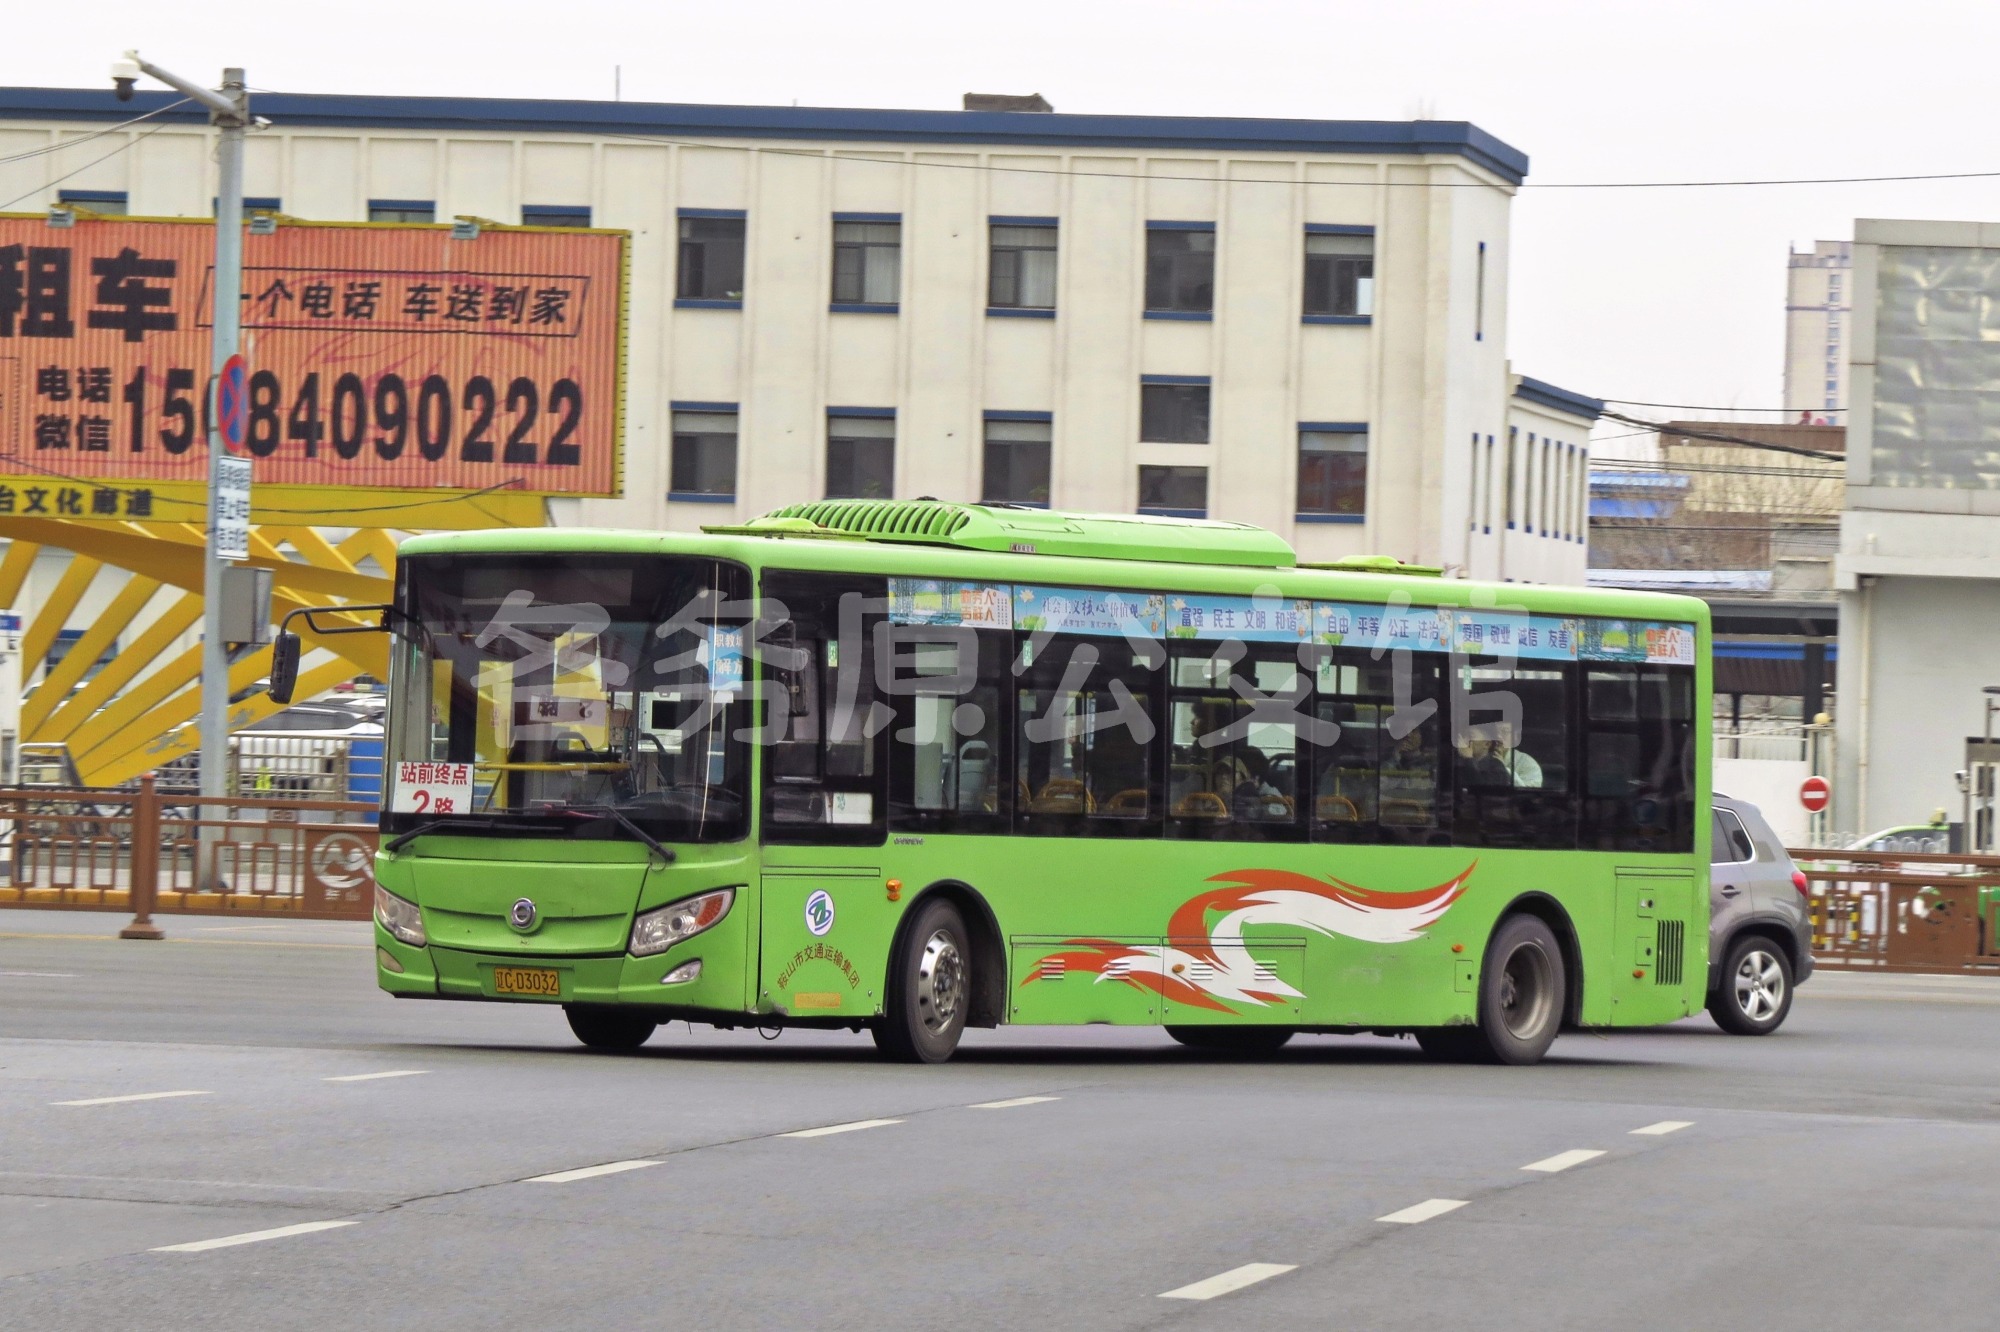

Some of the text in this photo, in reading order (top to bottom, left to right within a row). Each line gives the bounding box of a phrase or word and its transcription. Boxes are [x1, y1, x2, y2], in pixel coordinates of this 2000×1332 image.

[0, 243, 178, 342] 租车
[240, 279, 571, 325] 个电话 车送到家
[37, 364, 112, 403] 电话
[35, 412, 112, 452] 微信
[124, 365, 583, 467] 1584090222
[1042, 596, 1139, 619] 社会主义核心价值观
[1181, 606, 1297, 631] 富强 民主 文明 和谐
[1327, 615, 1440, 640] 自由 平等 公正 法治
[1462, 623, 1569, 649] 爱国 敬业 诚信 友善
[400, 761, 469, 785] 站前终点
[412, 789, 455, 815] 2路
[777, 942, 861, 991] 鞍山市交通运输集团
